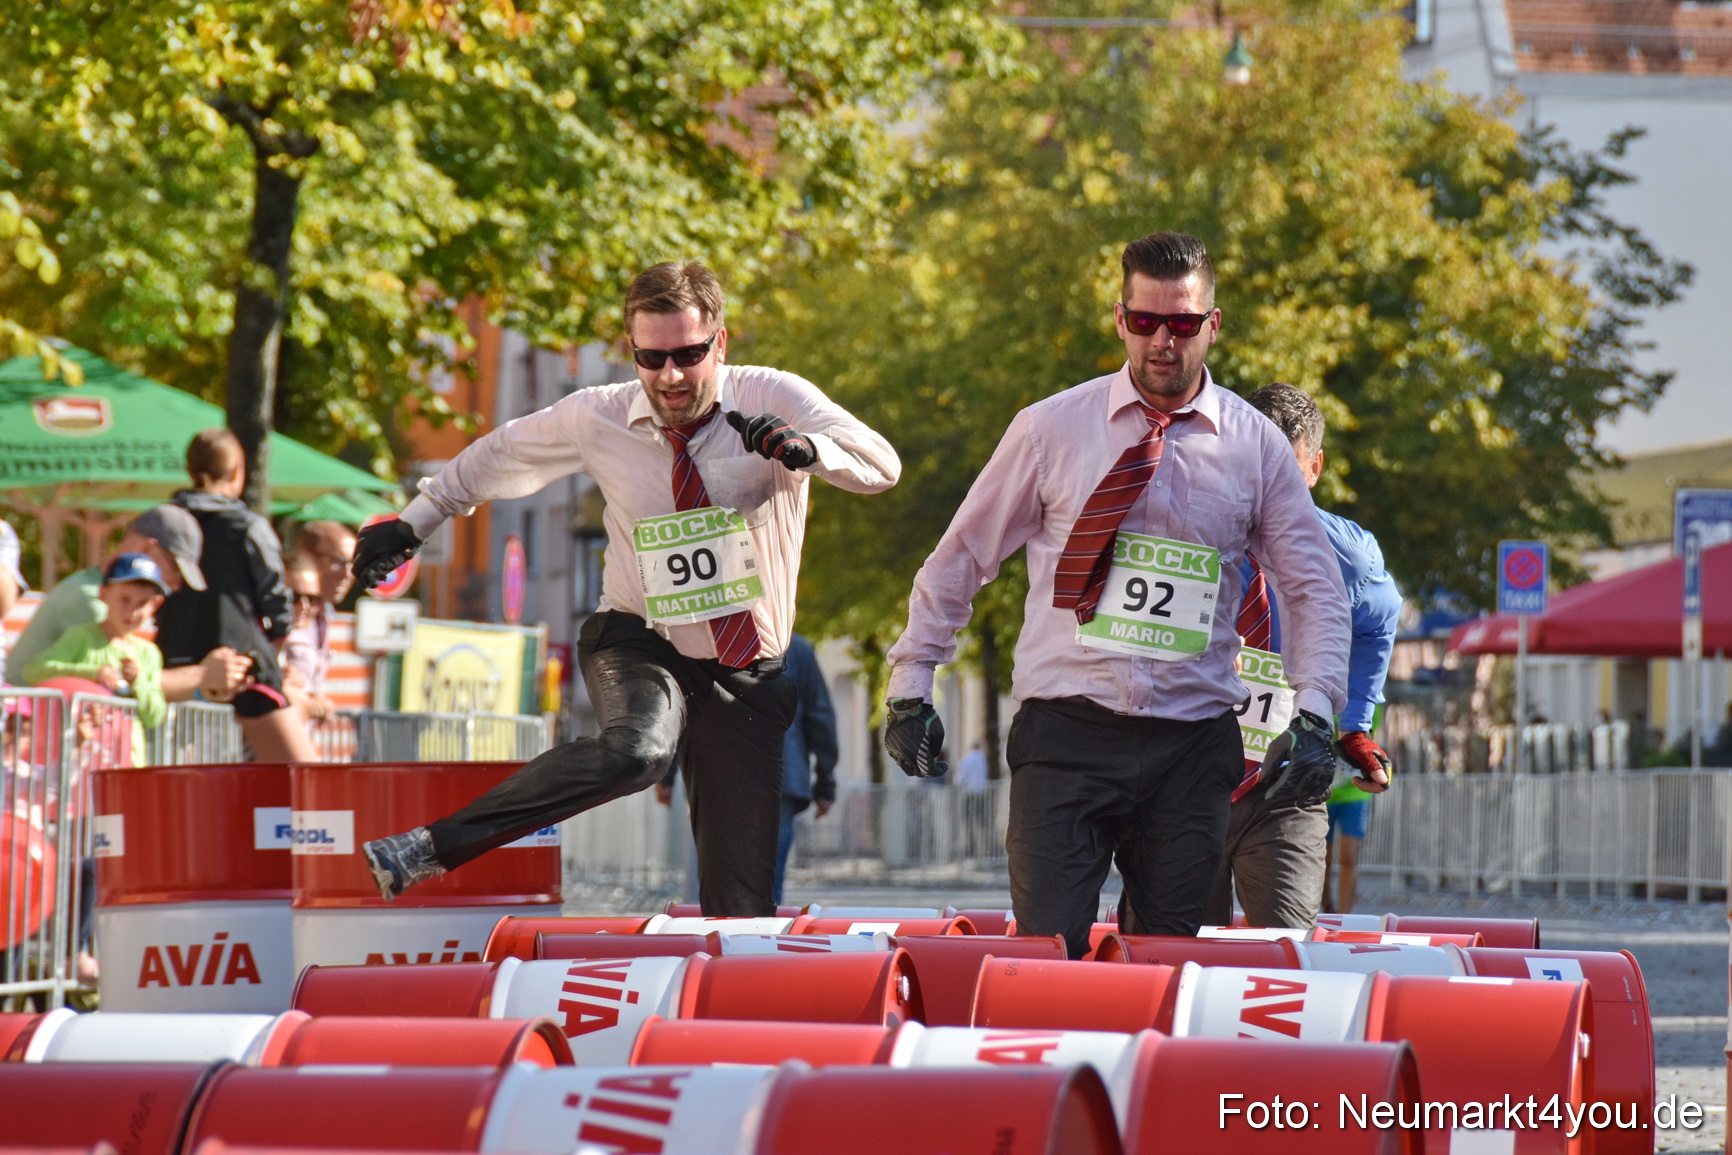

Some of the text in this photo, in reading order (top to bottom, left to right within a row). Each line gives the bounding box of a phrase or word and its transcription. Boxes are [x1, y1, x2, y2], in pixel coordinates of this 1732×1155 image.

[638, 509, 741, 548] BOCK
[667, 548, 717, 586] 90
[656, 584, 749, 614] MATTHIAS
[1122, 577, 1175, 618] 92
[1203, 592, 1213, 600] E6
[1109, 621, 1175, 647] MARIO
